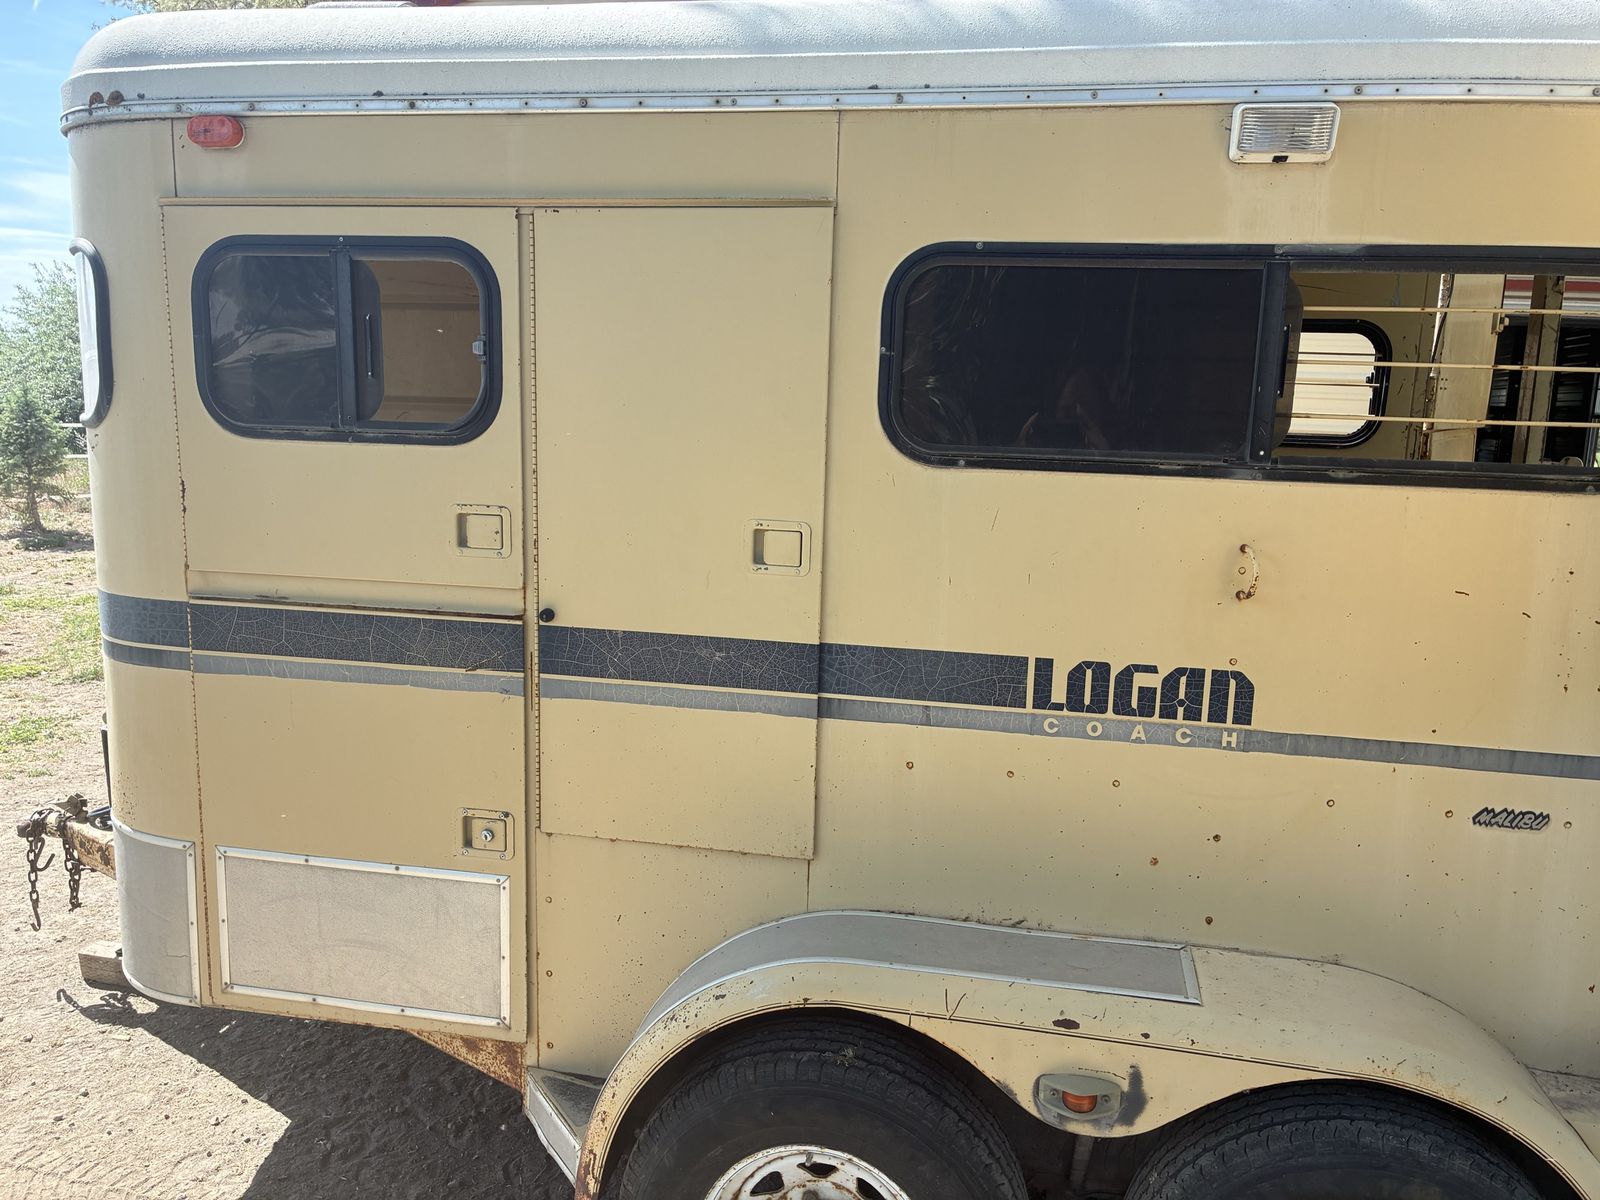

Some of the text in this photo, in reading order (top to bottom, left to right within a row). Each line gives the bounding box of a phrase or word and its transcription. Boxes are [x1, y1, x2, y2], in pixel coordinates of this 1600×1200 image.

[1031, 657, 1255, 726] LOGAN
[1043, 717, 1237, 748] COACH
[1472, 807, 1550, 831] MALIBU
